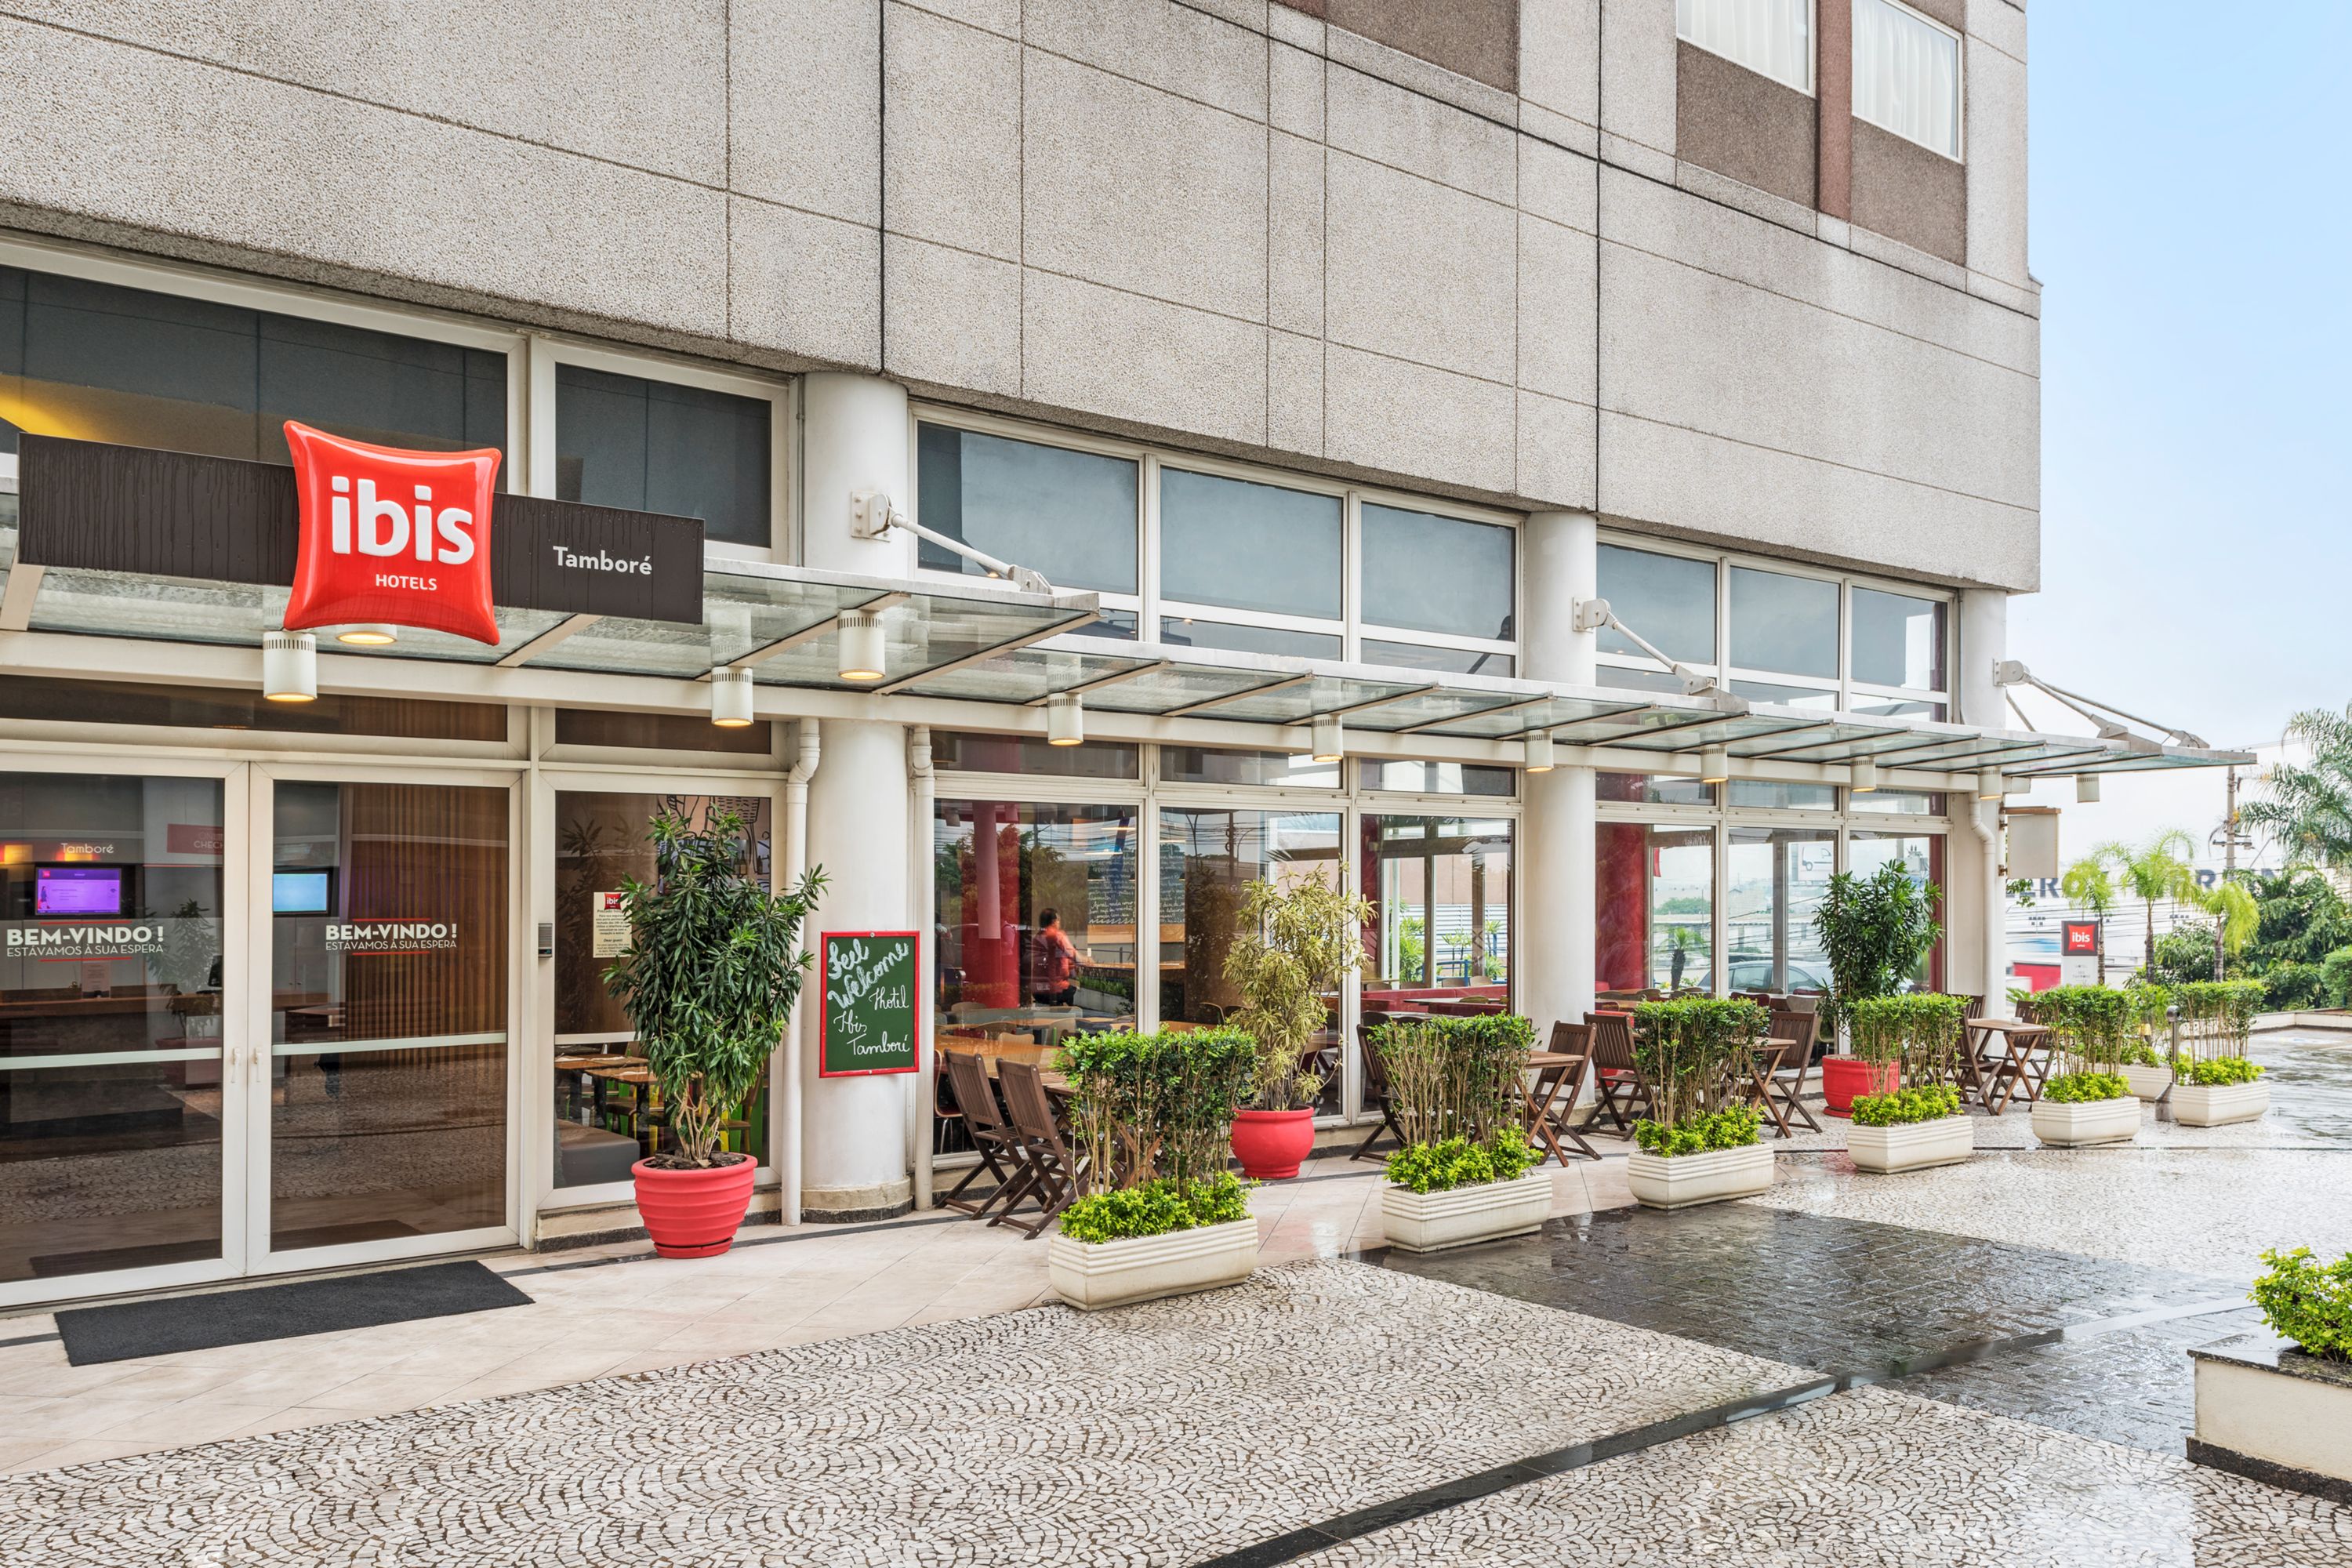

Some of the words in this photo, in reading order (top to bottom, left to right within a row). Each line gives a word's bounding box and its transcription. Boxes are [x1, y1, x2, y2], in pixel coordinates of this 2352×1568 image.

[331, 476, 475, 565] ibis
[553, 545, 653, 576] Tamboré
[375, 573, 437, 592] HOTELS
[60, 842, 114, 855] Tamboré
[326, 939, 389, 951] ESTÁVAMOS
[390, 938, 398, 949] À
[399, 940, 419, 949] SUA
[420, 939, 457, 949] ESPERA
[2071, 931, 2091, 942] ibis
[7, 945, 82, 957] ESTÁVAMOS
[84, 944, 93, 955] À
[95, 945, 118, 954] SUA
[121, 944, 164, 954] ESPERA
[827, 942, 909, 1009] Welcome
